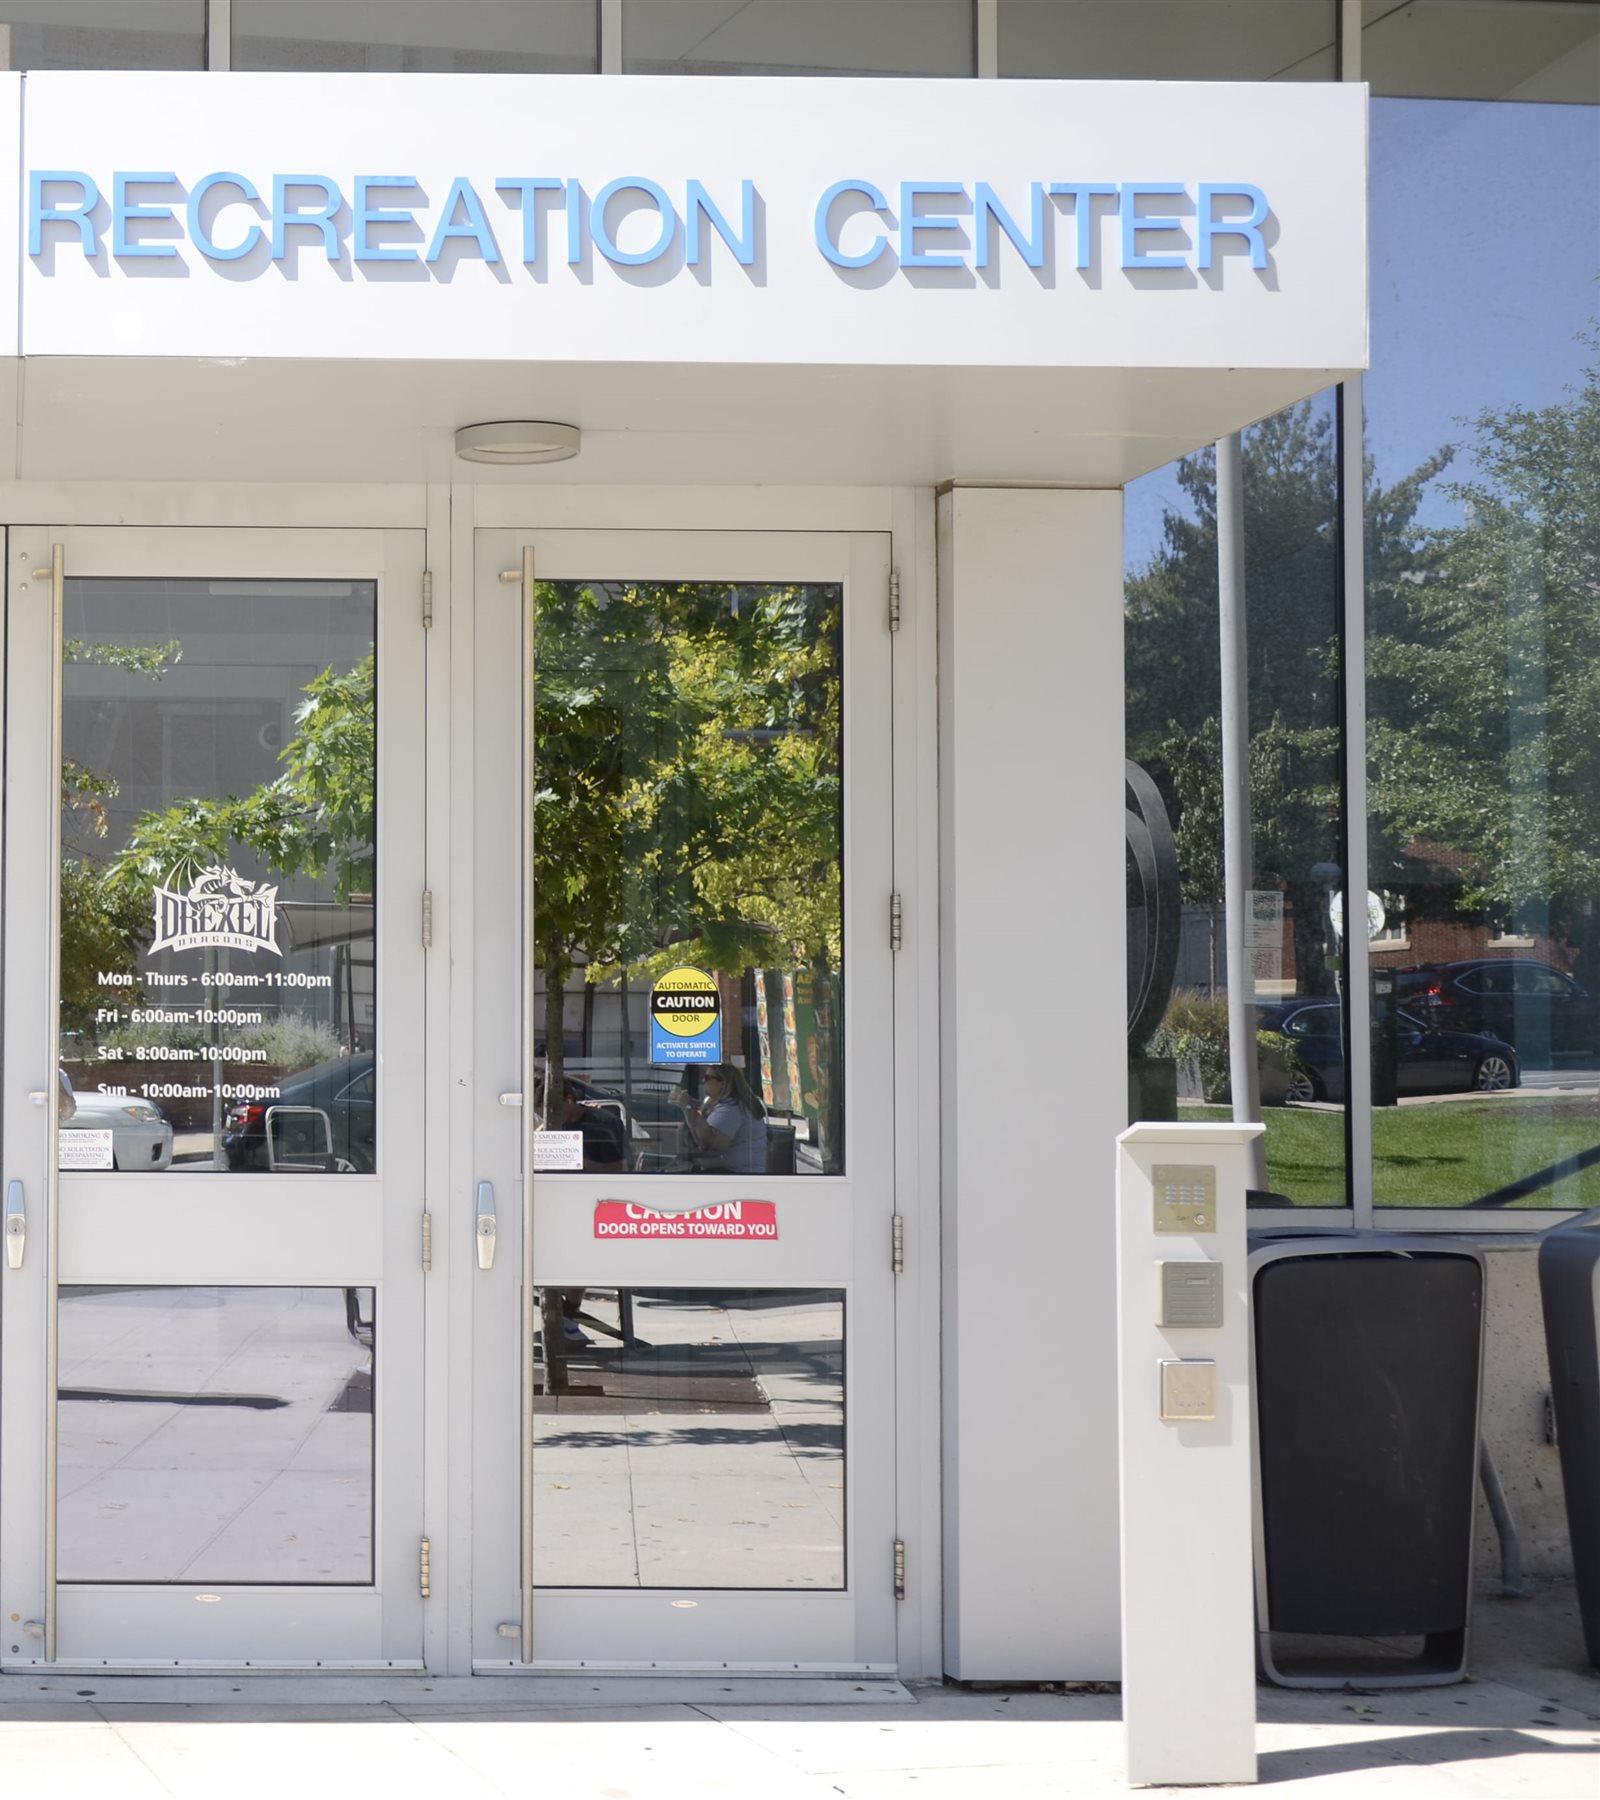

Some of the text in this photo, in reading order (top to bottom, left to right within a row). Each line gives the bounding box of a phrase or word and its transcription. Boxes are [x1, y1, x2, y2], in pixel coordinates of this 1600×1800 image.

[27, 170, 754, 266] RECREATION
[814, 178, 1269, 270] CENTER
[160, 890, 270, 939] DREXEL
[178, 935, 254, 948] DRAGONS
[97, 971, 133, 986] Mon
[145, 971, 189, 987] Thurs
[200, 972, 332, 989] 6:00am-11:00pm
[658, 981, 713, 990] AUTOMATIC
[656, 996, 715, 1008] CAUTION
[97, 1008, 118, 1023] Fri
[131, 1009, 262, 1025] 6:00am-10:00pm
[671, 1014, 700, 1023] DOOR
[97, 1047, 123, 1061] Sat
[135, 1047, 267, 1063] 8:00am-10:00pm
[97, 1083, 127, 1097] Sun
[140, 1084, 281, 1100] 10:00am-10:00pm
[625, 1200, 742, 1220] CAION
[598, 1222, 776, 1236] DOOR OPENS TOWARD YOU
